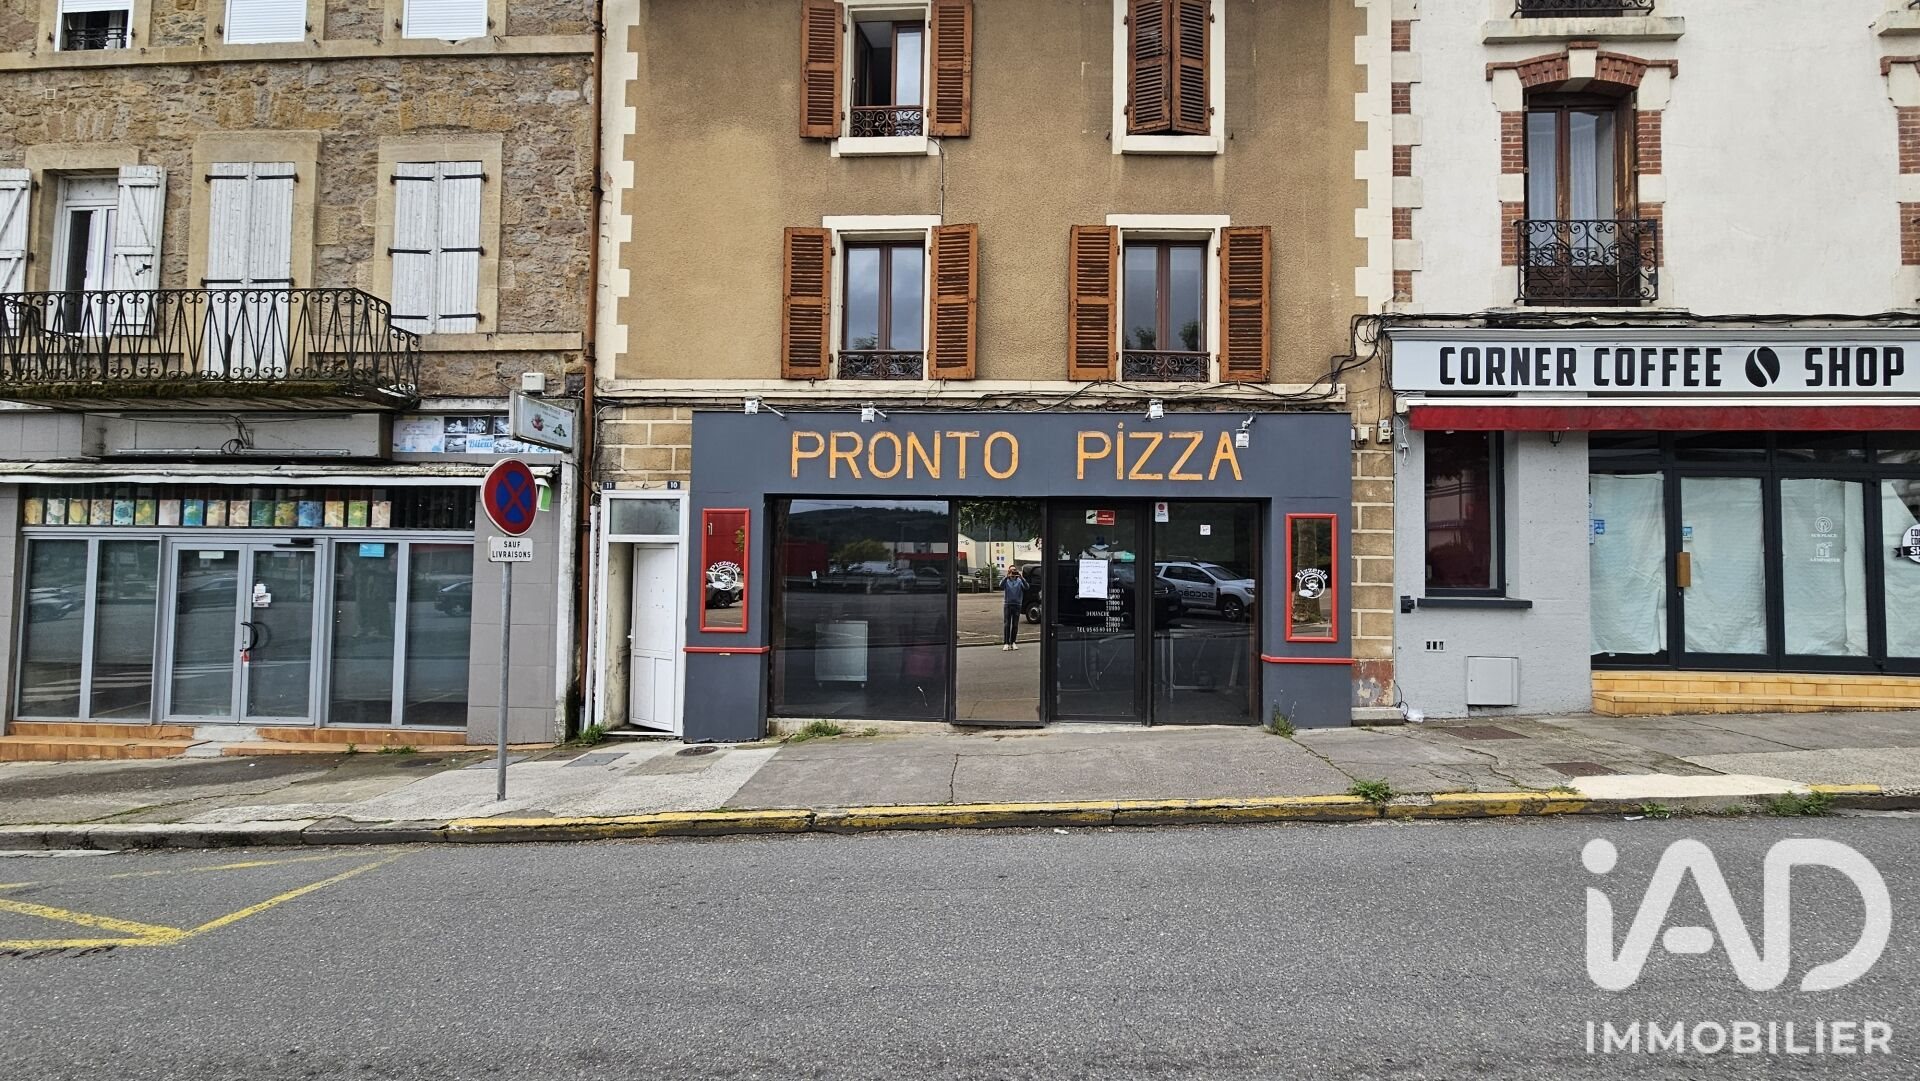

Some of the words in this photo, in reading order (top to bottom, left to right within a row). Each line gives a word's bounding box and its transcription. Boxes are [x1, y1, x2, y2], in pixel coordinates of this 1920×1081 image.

[1439, 346, 1577, 386] CORNER
[1593, 346, 1723, 387] COFFEE
[1805, 346, 1905, 387] SHOP
[790, 430, 1019, 481] PRONTO
[606, 482, 613, 490] 11
[670, 481, 678, 490] 10
[709, 560, 742, 573] Pizzeria
[1295, 567, 1329, 580] Pizzeria
